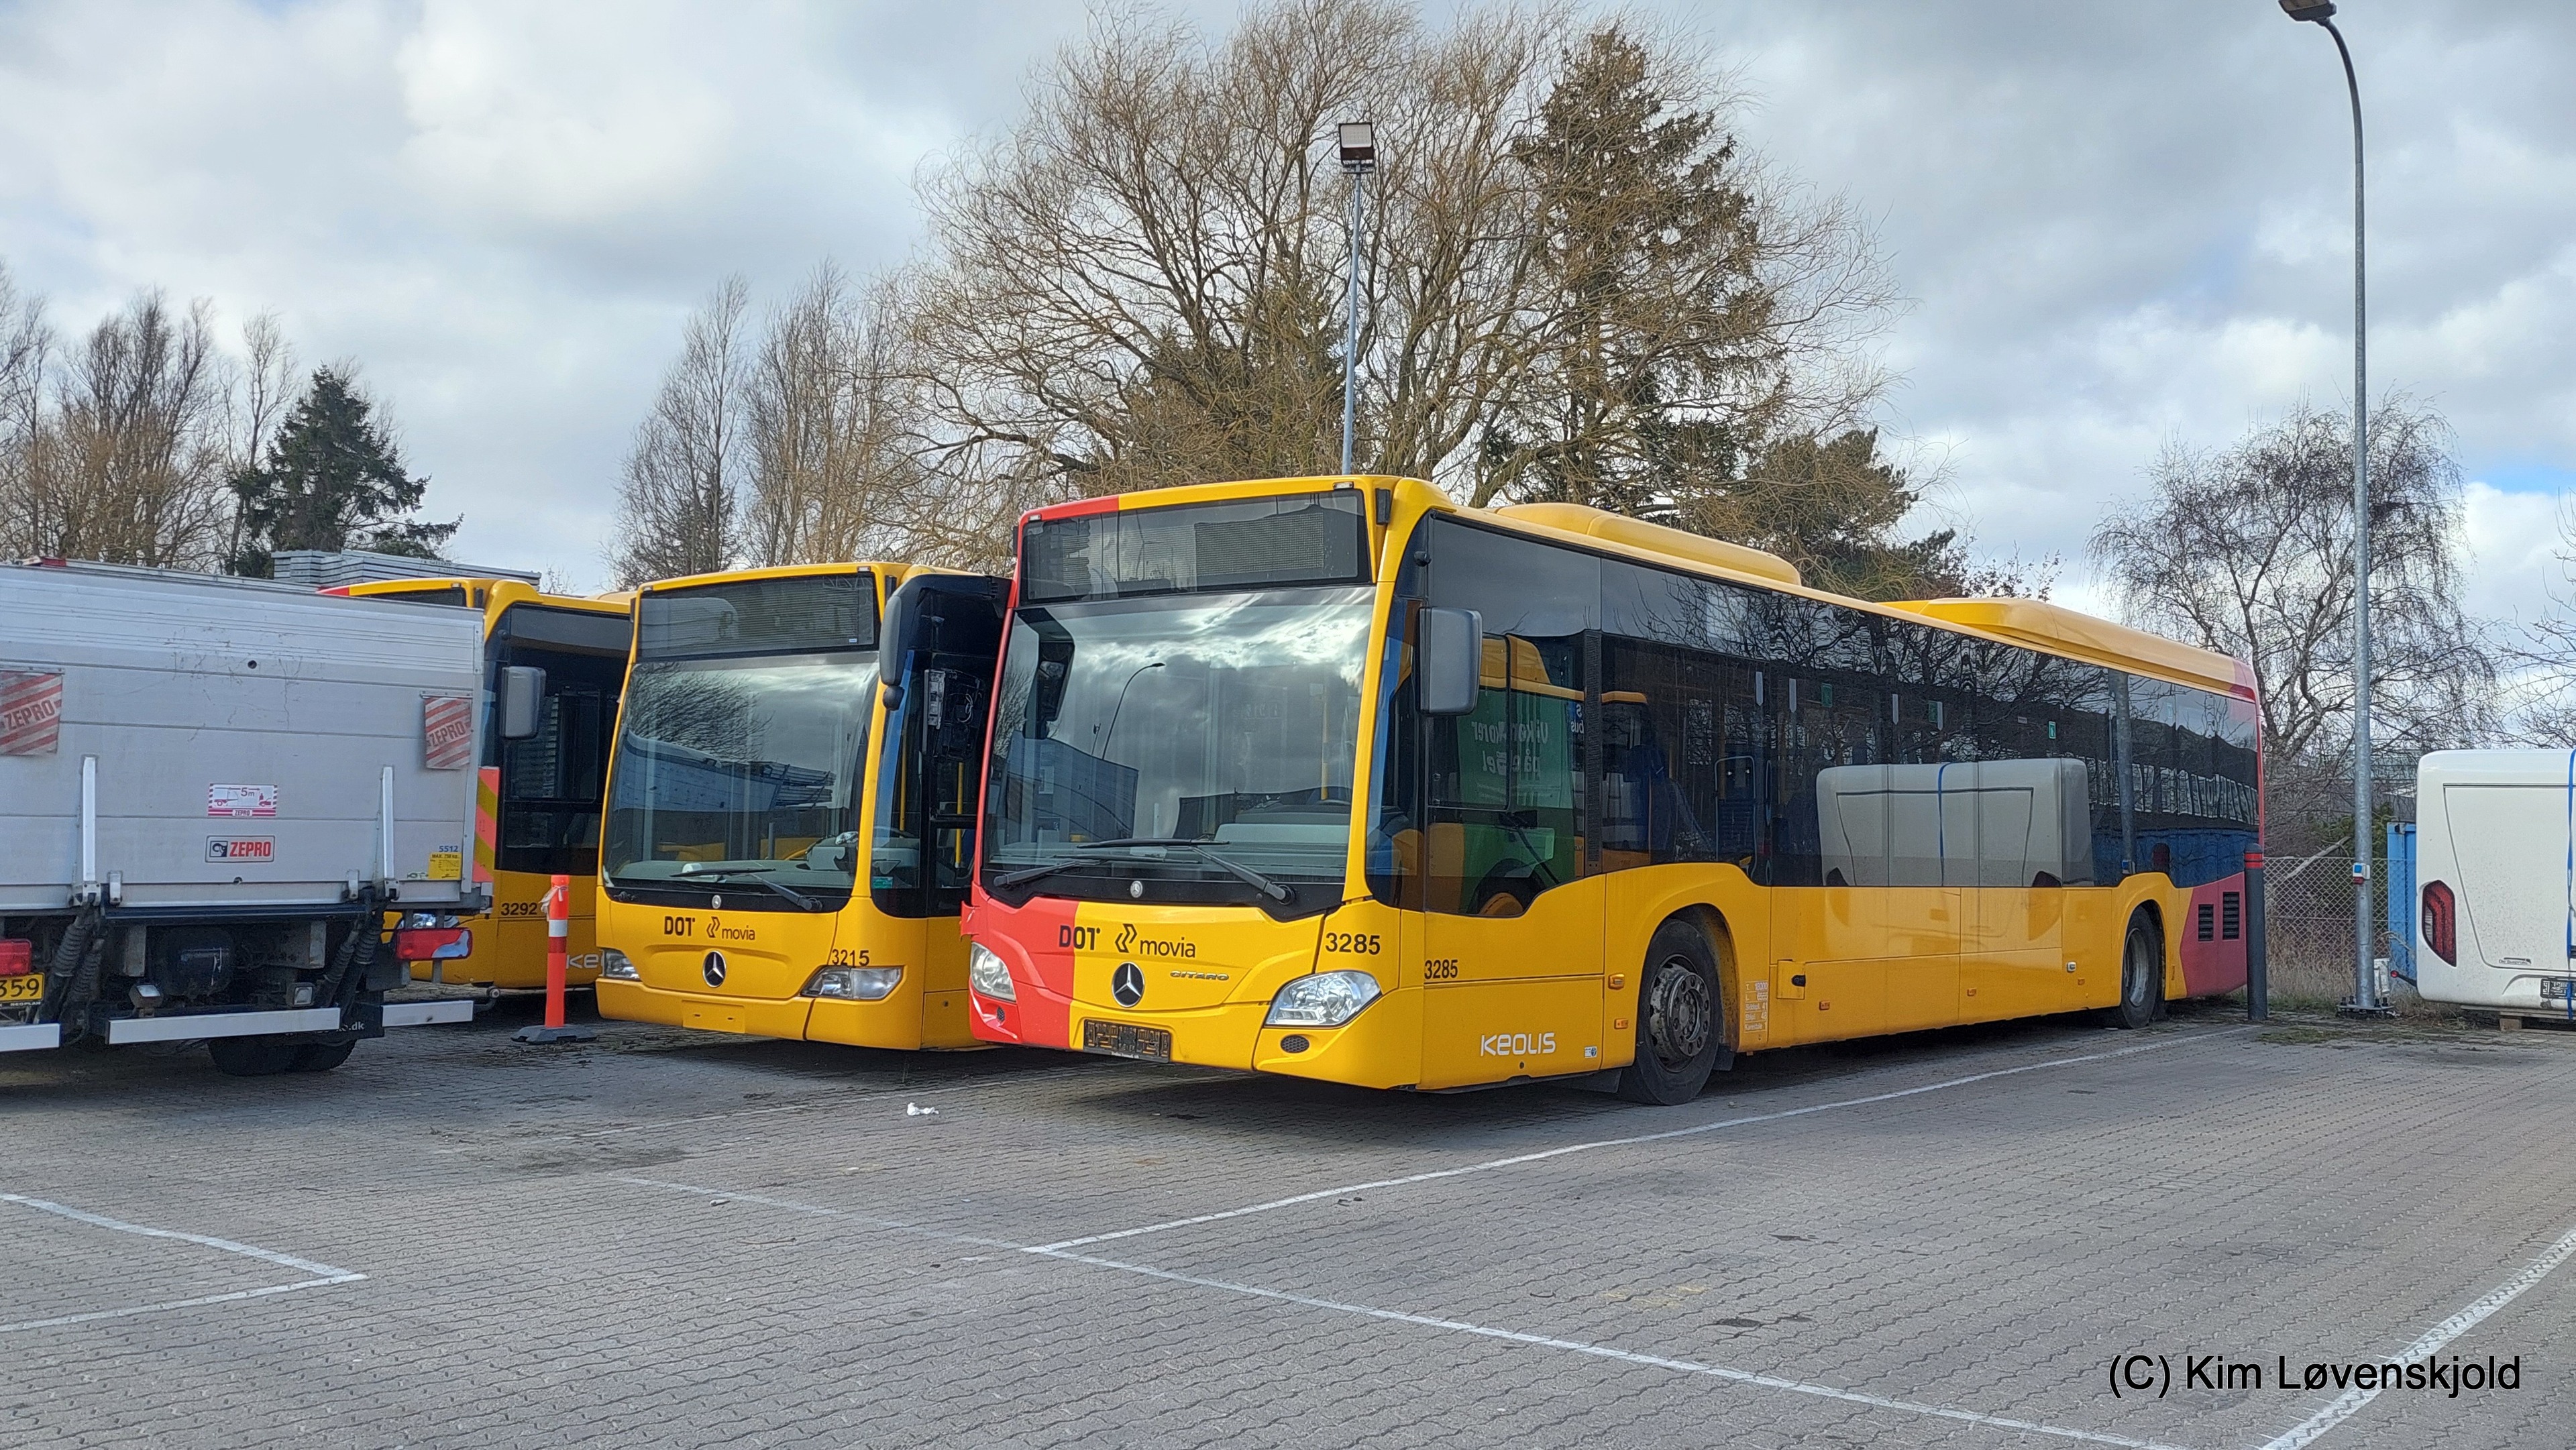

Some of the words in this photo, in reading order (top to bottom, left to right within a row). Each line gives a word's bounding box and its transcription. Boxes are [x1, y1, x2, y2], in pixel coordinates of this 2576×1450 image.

[3, 700, 55, 730] ZEPRO
[429, 721, 466, 747] ZEPRO
[229, 841, 272, 857] ZEPRO
[500, 902, 537, 916] 3292
[721, 925, 755, 941] movia
[1139, 936, 1196, 958] movia
[1325, 932, 1381, 956] 3285
[832, 948, 870, 967] 3215
[1169, 970, 1230, 981] CITARO
[1424, 959, 1458, 980] 3285
